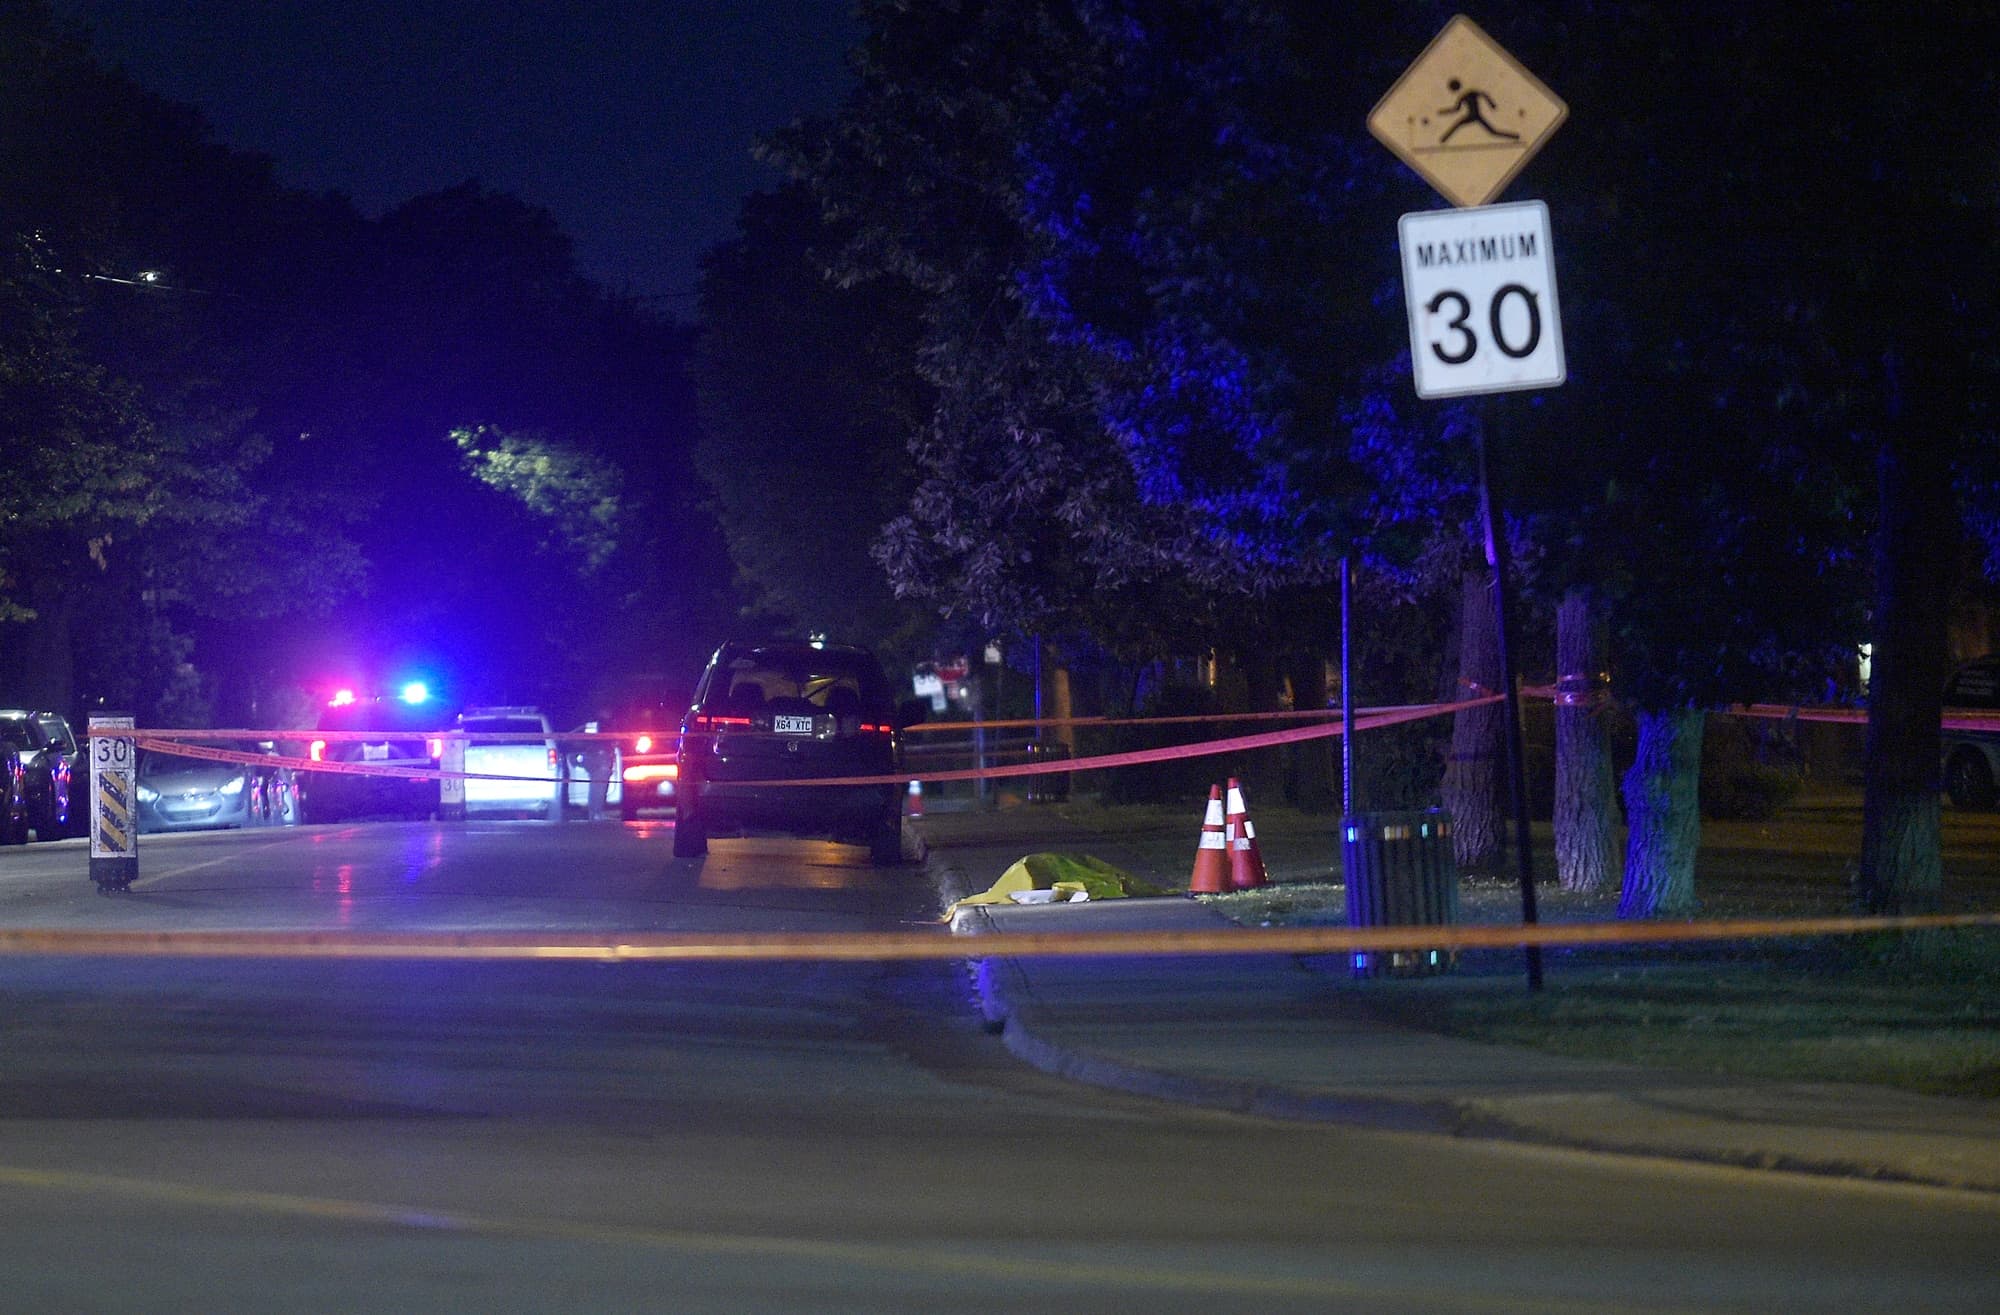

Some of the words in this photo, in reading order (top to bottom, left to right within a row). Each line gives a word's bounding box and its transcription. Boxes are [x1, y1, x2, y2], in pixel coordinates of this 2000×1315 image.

[1416, 232, 1537, 268] MAXIMUM
[1428, 283, 1541, 365] 30
[796, 720, 811, 731] XTC
[98, 738, 127, 762] 30
